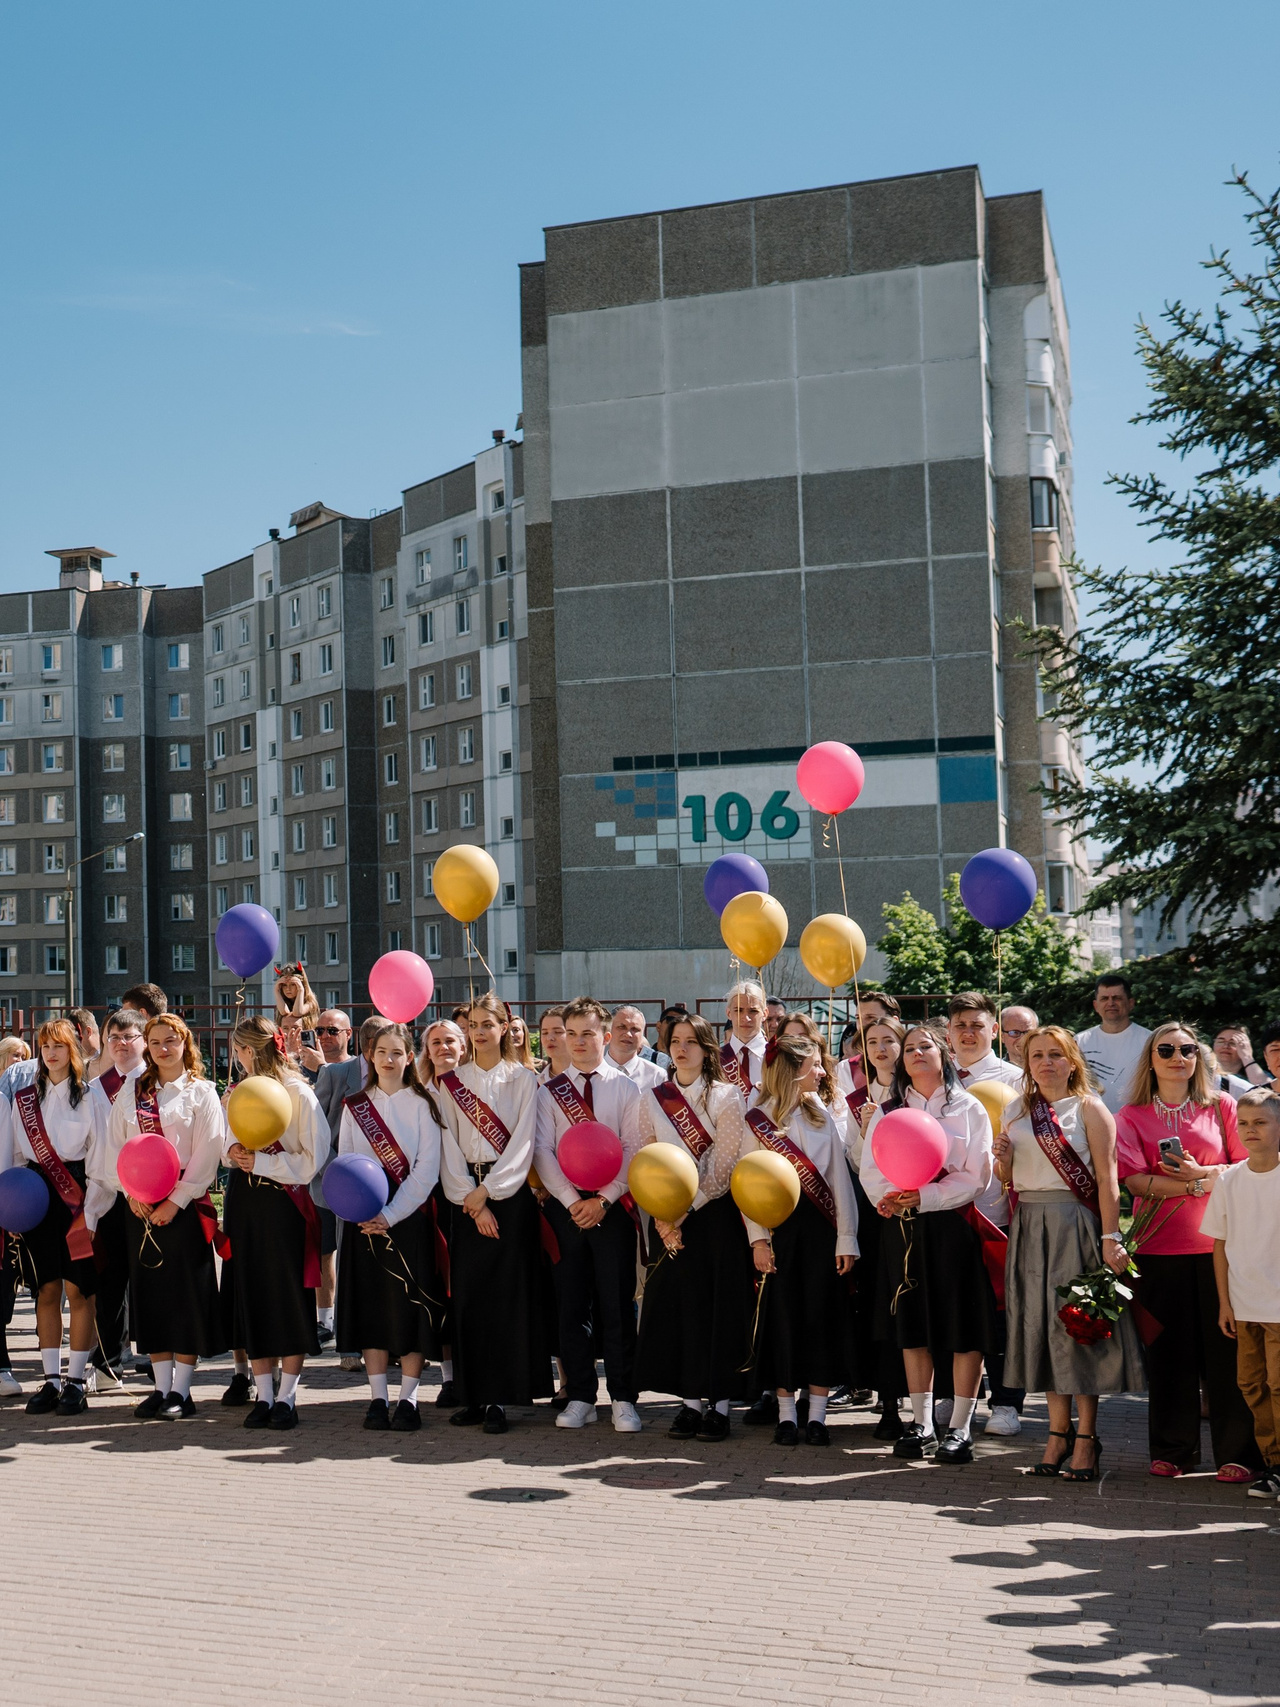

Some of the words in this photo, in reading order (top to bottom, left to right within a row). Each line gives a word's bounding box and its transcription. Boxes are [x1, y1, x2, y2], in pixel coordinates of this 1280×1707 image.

[683, 790, 799, 843] 106
[51, 1167, 74, 1195] 2024
[1069, 1166, 1095, 1199] 2024
